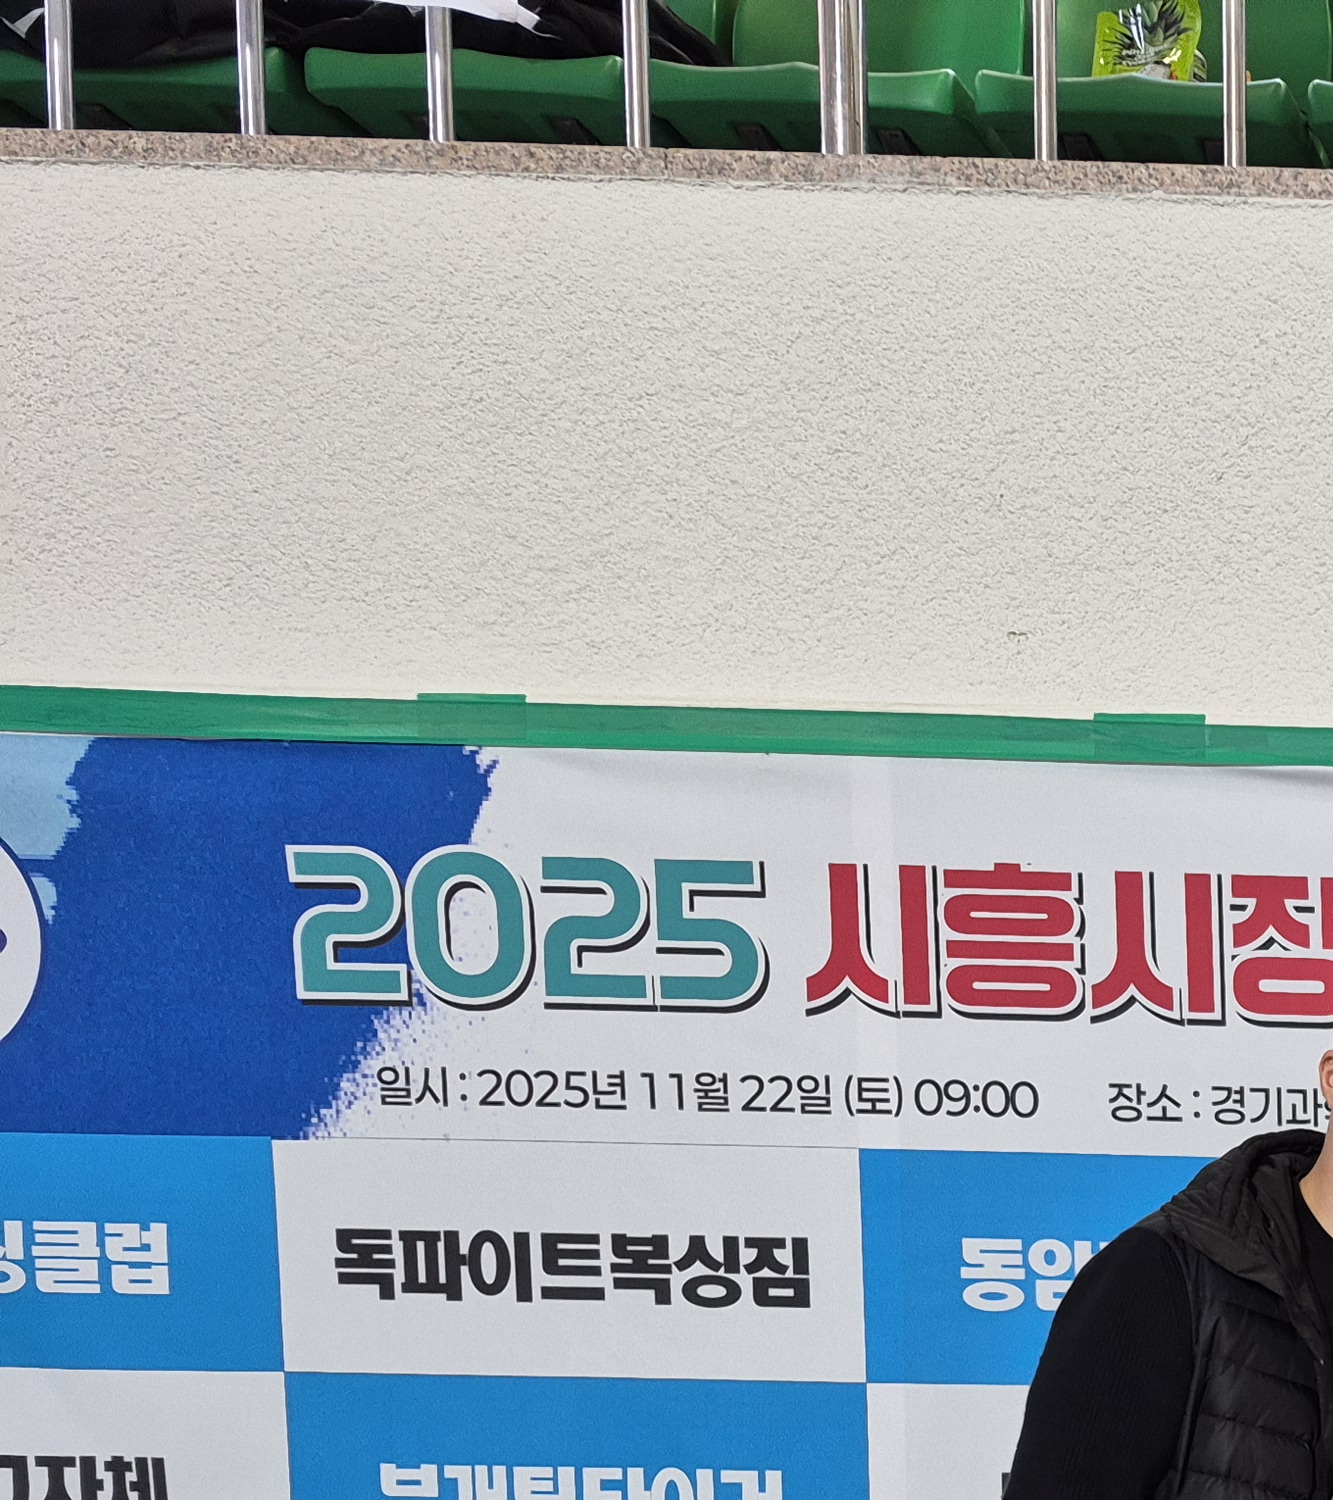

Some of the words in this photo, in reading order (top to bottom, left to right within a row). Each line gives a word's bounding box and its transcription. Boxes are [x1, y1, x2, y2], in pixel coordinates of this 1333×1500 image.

[285, 844, 771, 1011] 2025
[476, 1069, 628, 1110] 2025년
[640, 1072, 730, 1113] 11월
[739, 1074, 833, 1115] 22일
[844, 1074, 903, 1118] (토)
[914, 1078, 1040, 1118] 09:00
[1211, 1085, 1331, 1127] 경기과
[334, 1228, 812, 1309] 독파이트복싱짐
